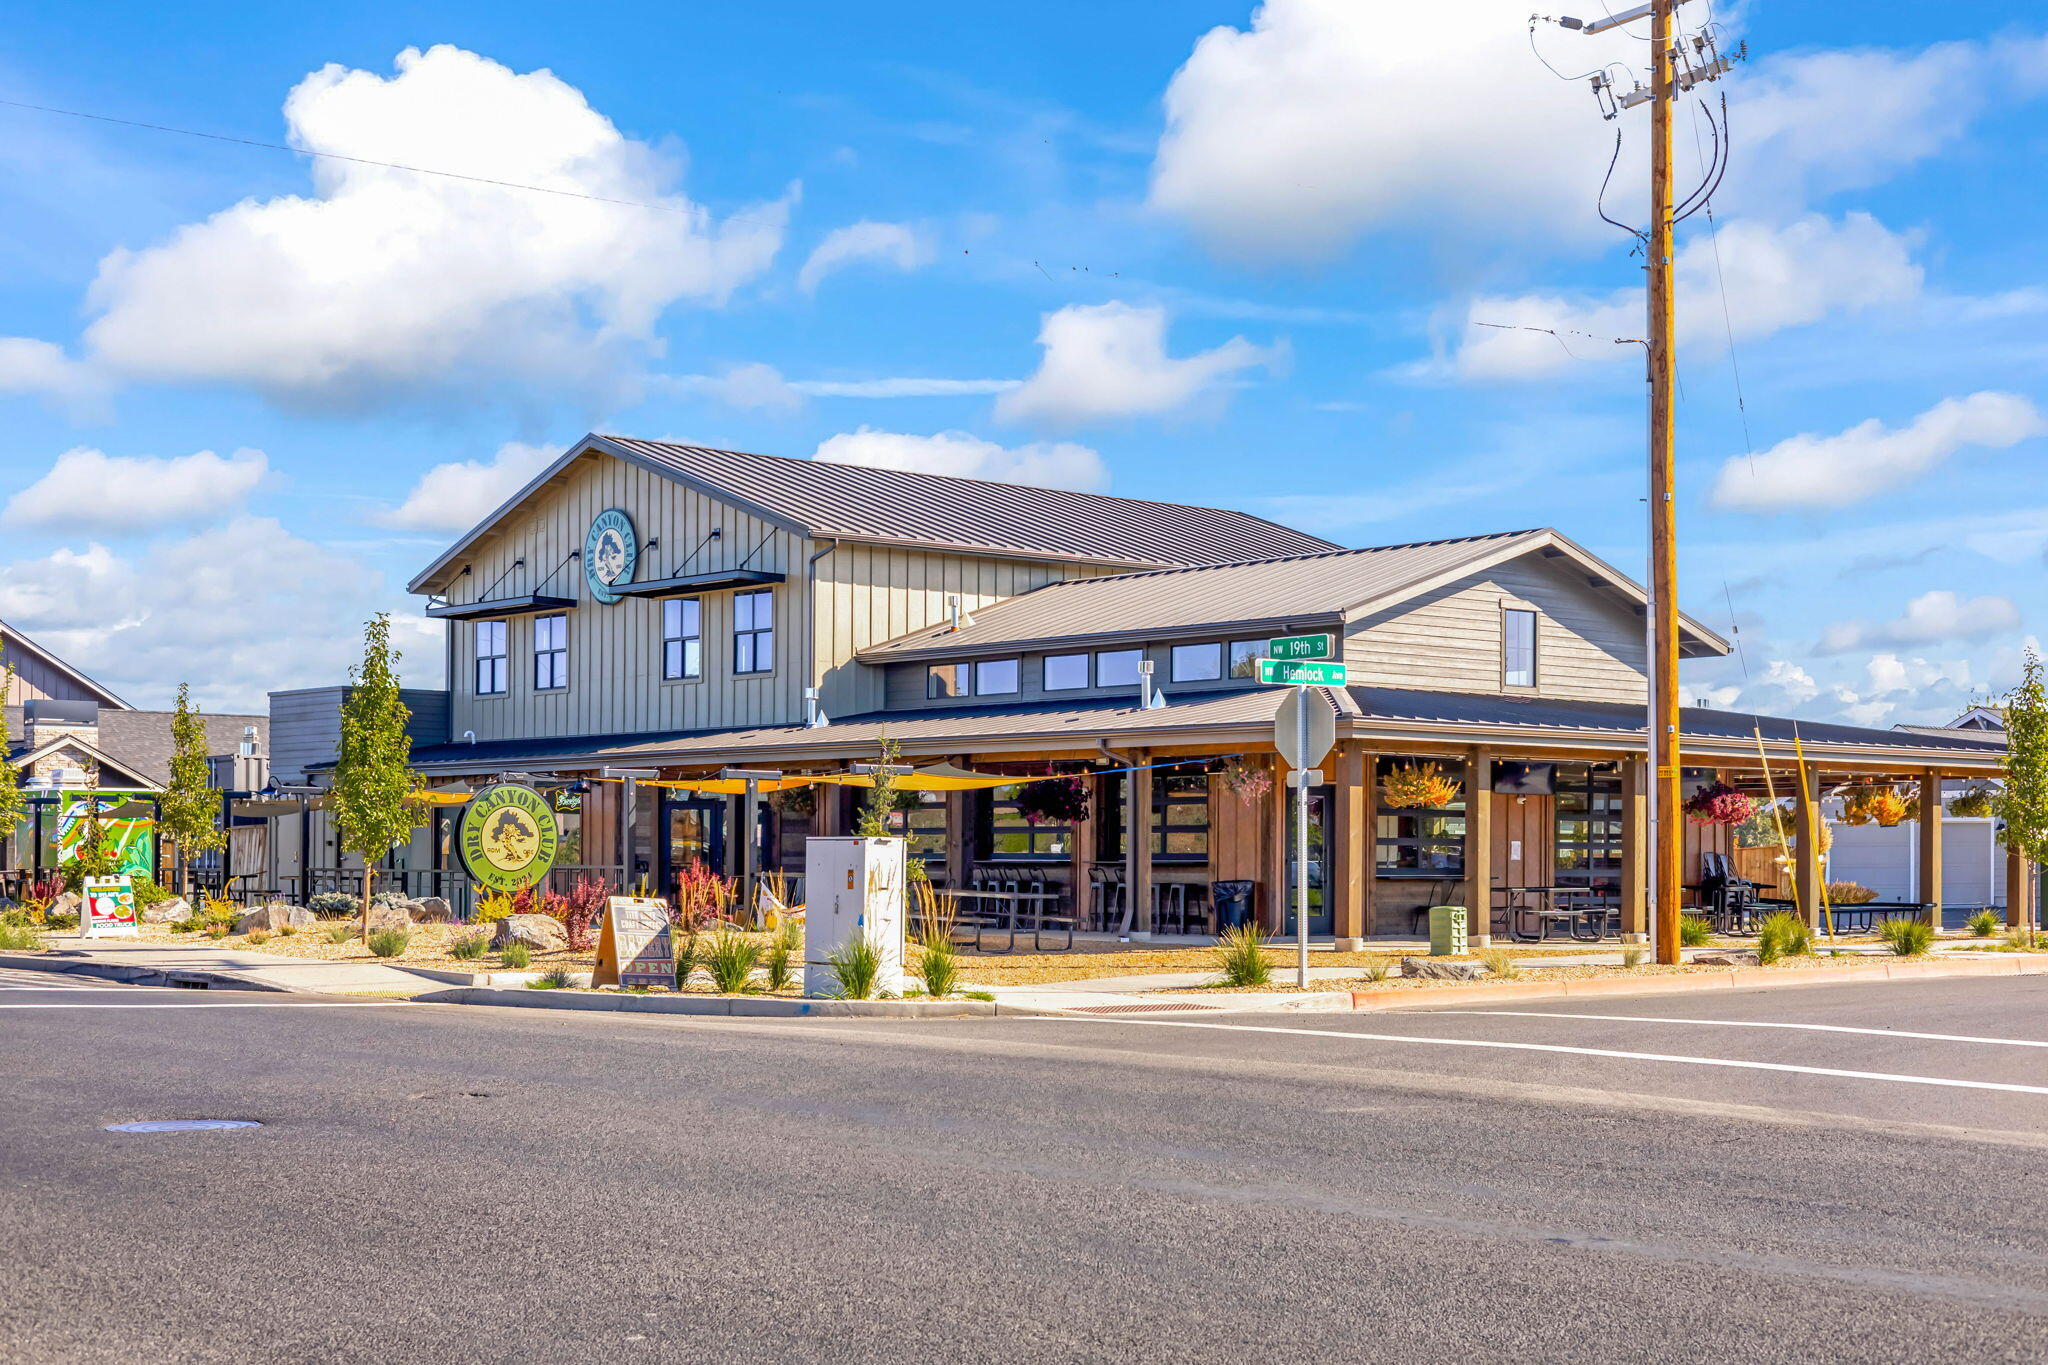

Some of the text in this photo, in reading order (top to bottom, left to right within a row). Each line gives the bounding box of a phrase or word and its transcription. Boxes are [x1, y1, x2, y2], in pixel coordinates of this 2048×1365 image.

[591, 514, 626, 541] CANYON
[1273, 641, 1324, 656] NW 19th St
[1283, 665, 1325, 682] Hemlock
[1331, 669, 1344, 680] Ave
[467, 790, 554, 863] DRY CANYON CLUB
[488, 872, 507, 886] EST.
[621, 962, 672, 974] OPEN
